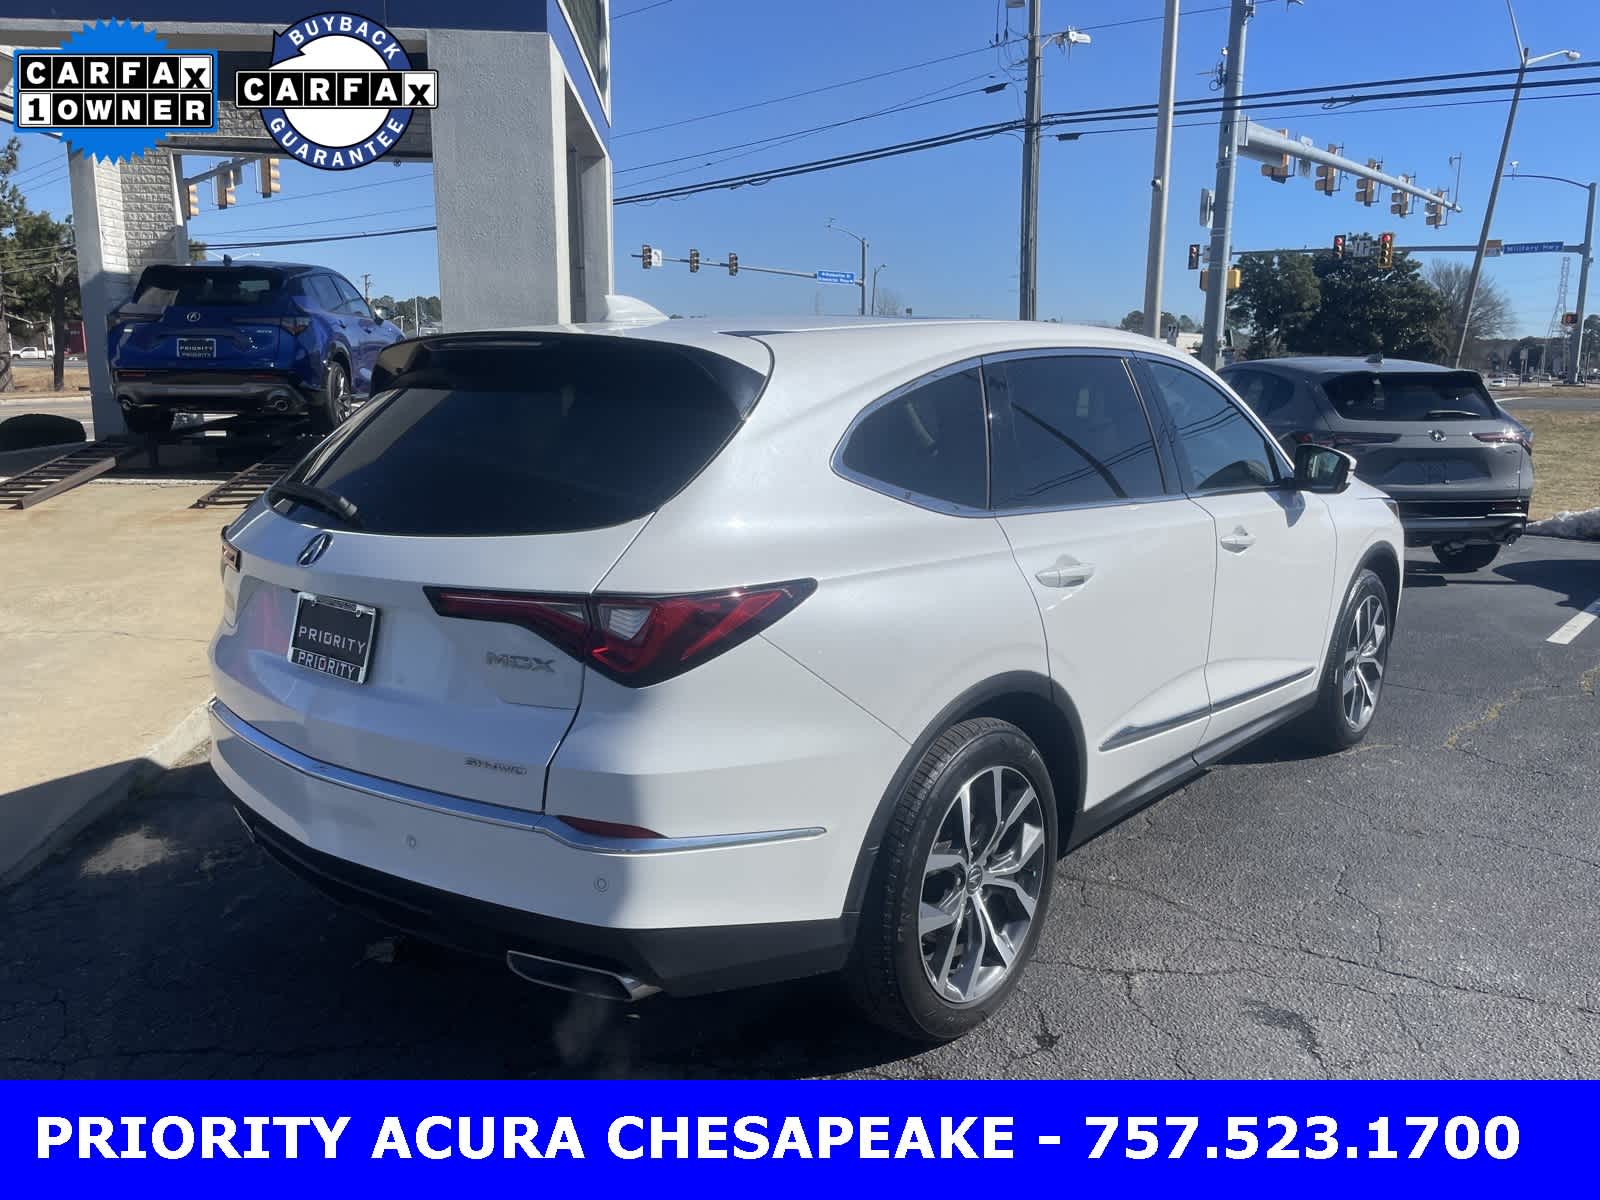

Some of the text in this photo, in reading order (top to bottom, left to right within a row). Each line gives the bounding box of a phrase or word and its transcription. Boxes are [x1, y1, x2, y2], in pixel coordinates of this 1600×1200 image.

[298, 625, 367, 655] PRIORITY
[297, 651, 356, 679] PRIORITY
[486, 651, 556, 673] MDX
